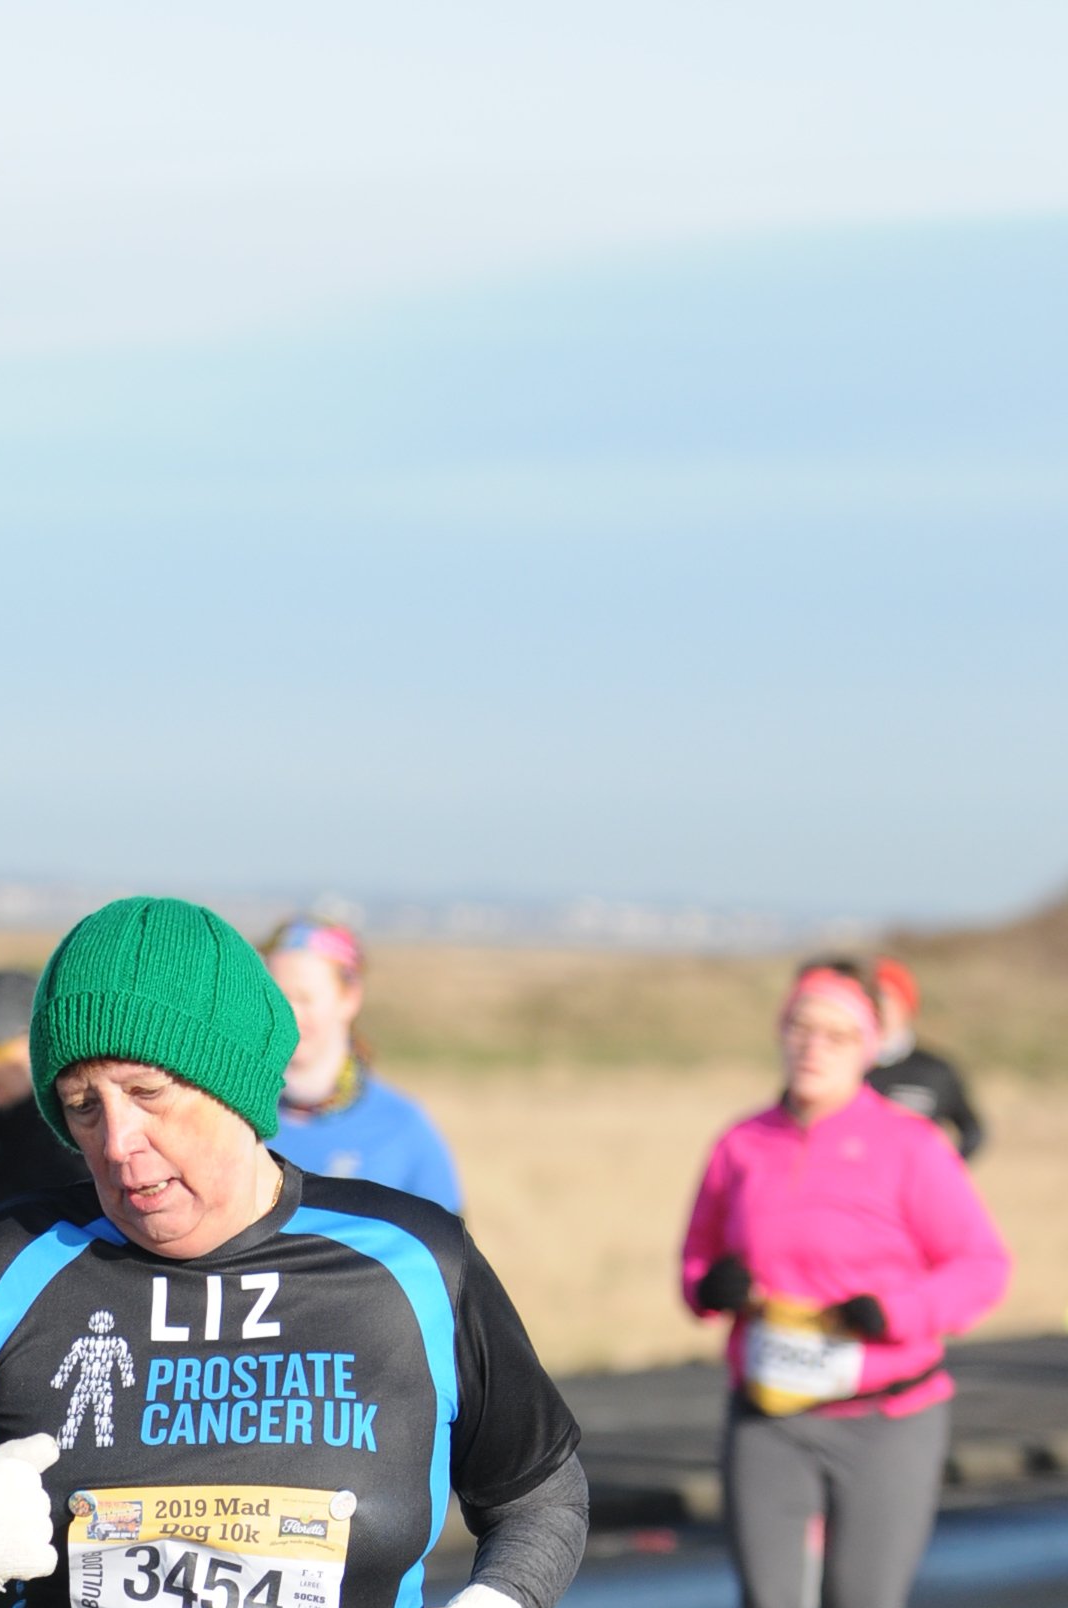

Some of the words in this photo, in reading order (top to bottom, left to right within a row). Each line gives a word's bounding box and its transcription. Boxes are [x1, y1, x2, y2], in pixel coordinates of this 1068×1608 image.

[150, 1272, 281, 1341] LIZ
[145, 1353, 357, 1401] PROSTATE
[140, 1400, 313, 1446] CANCER
[323, 1401, 379, 1452] UK
[155, 1499, 207, 1519] 2019
[213, 1497, 271, 1517] Mad
[159, 1523, 211, 1543] Dog
[219, 1523, 260, 1543] 10k
[293, 1592, 326, 1604] SOCKS
